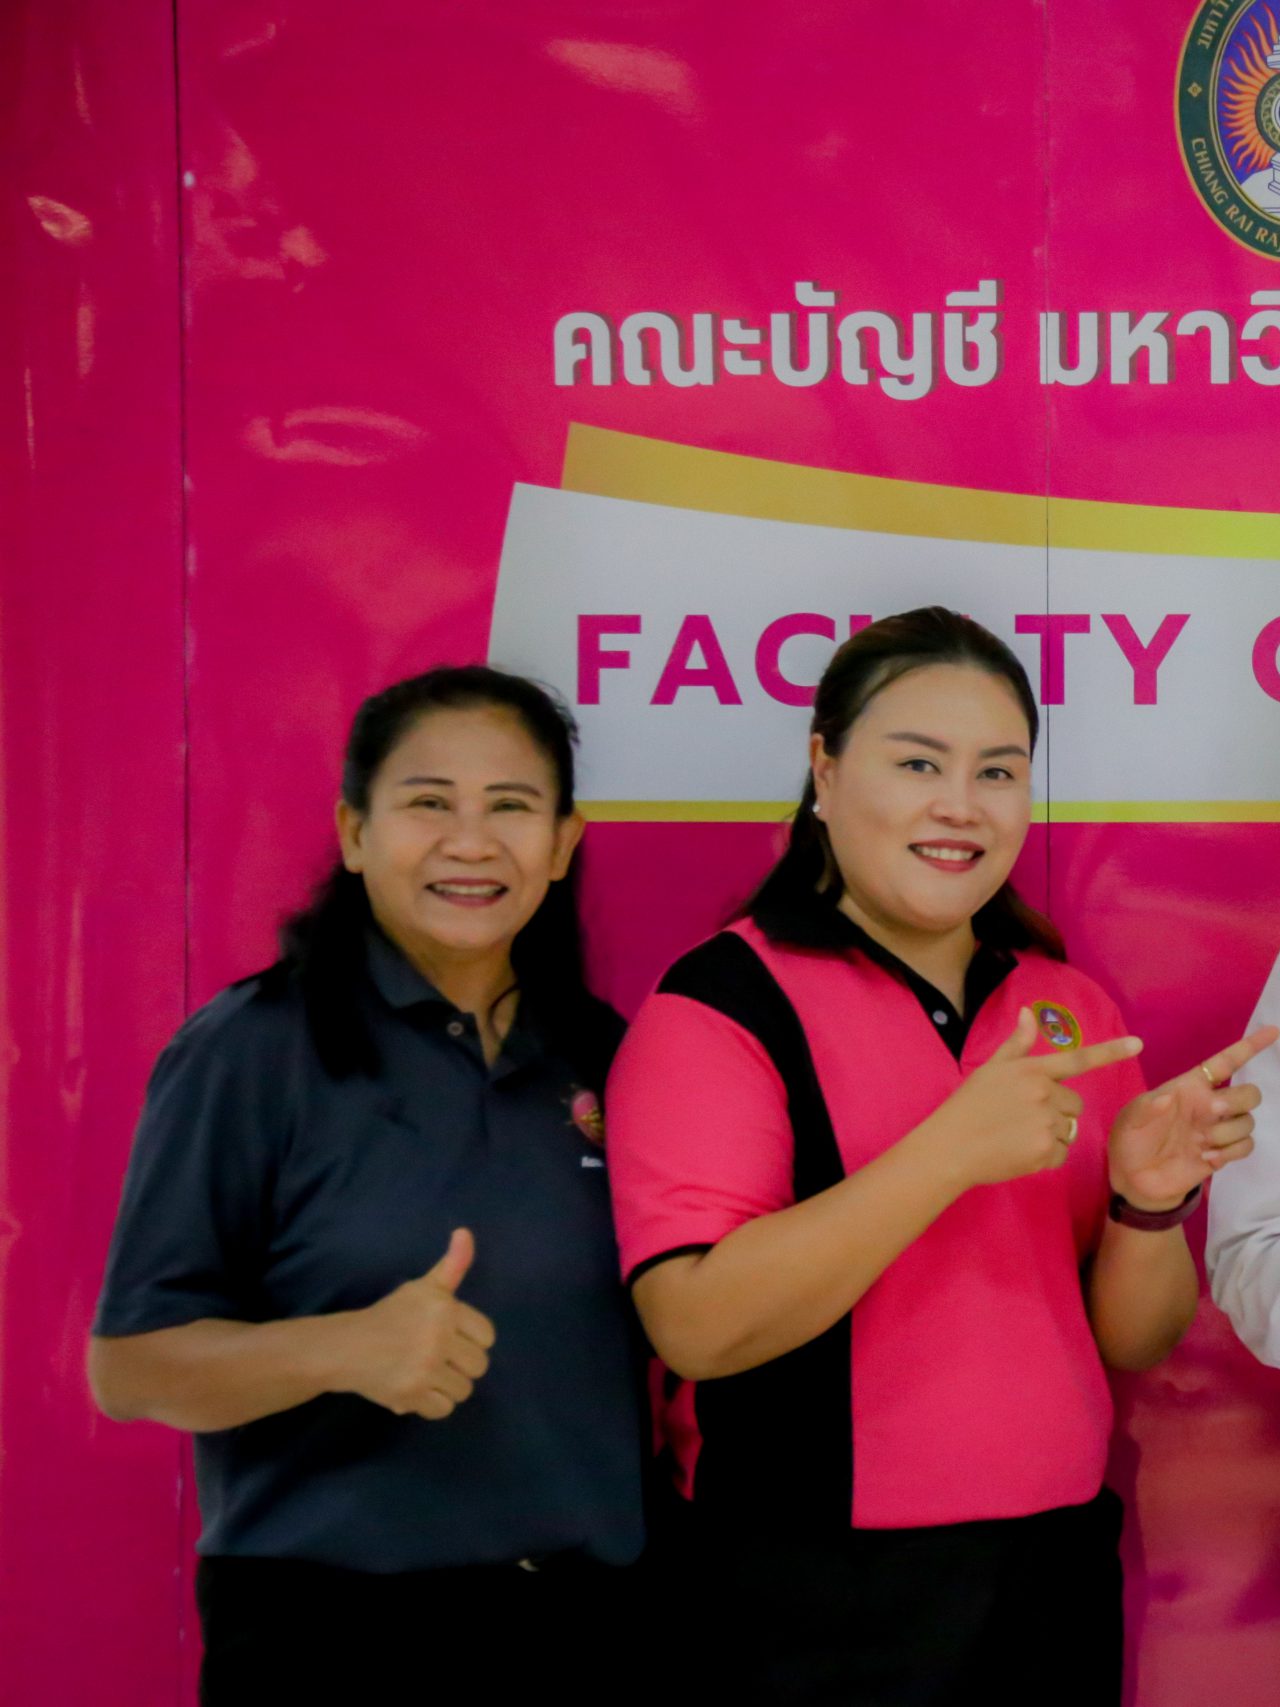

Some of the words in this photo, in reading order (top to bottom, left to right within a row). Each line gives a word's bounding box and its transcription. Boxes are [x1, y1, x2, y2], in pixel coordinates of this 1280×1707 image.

[1192, 137, 1229, 205] CHIANG
[1225, 204, 1254, 232] RAI
[553, 279, 1001, 400] คณะบัญชี
[577, 612, 1190, 706] FACTY
